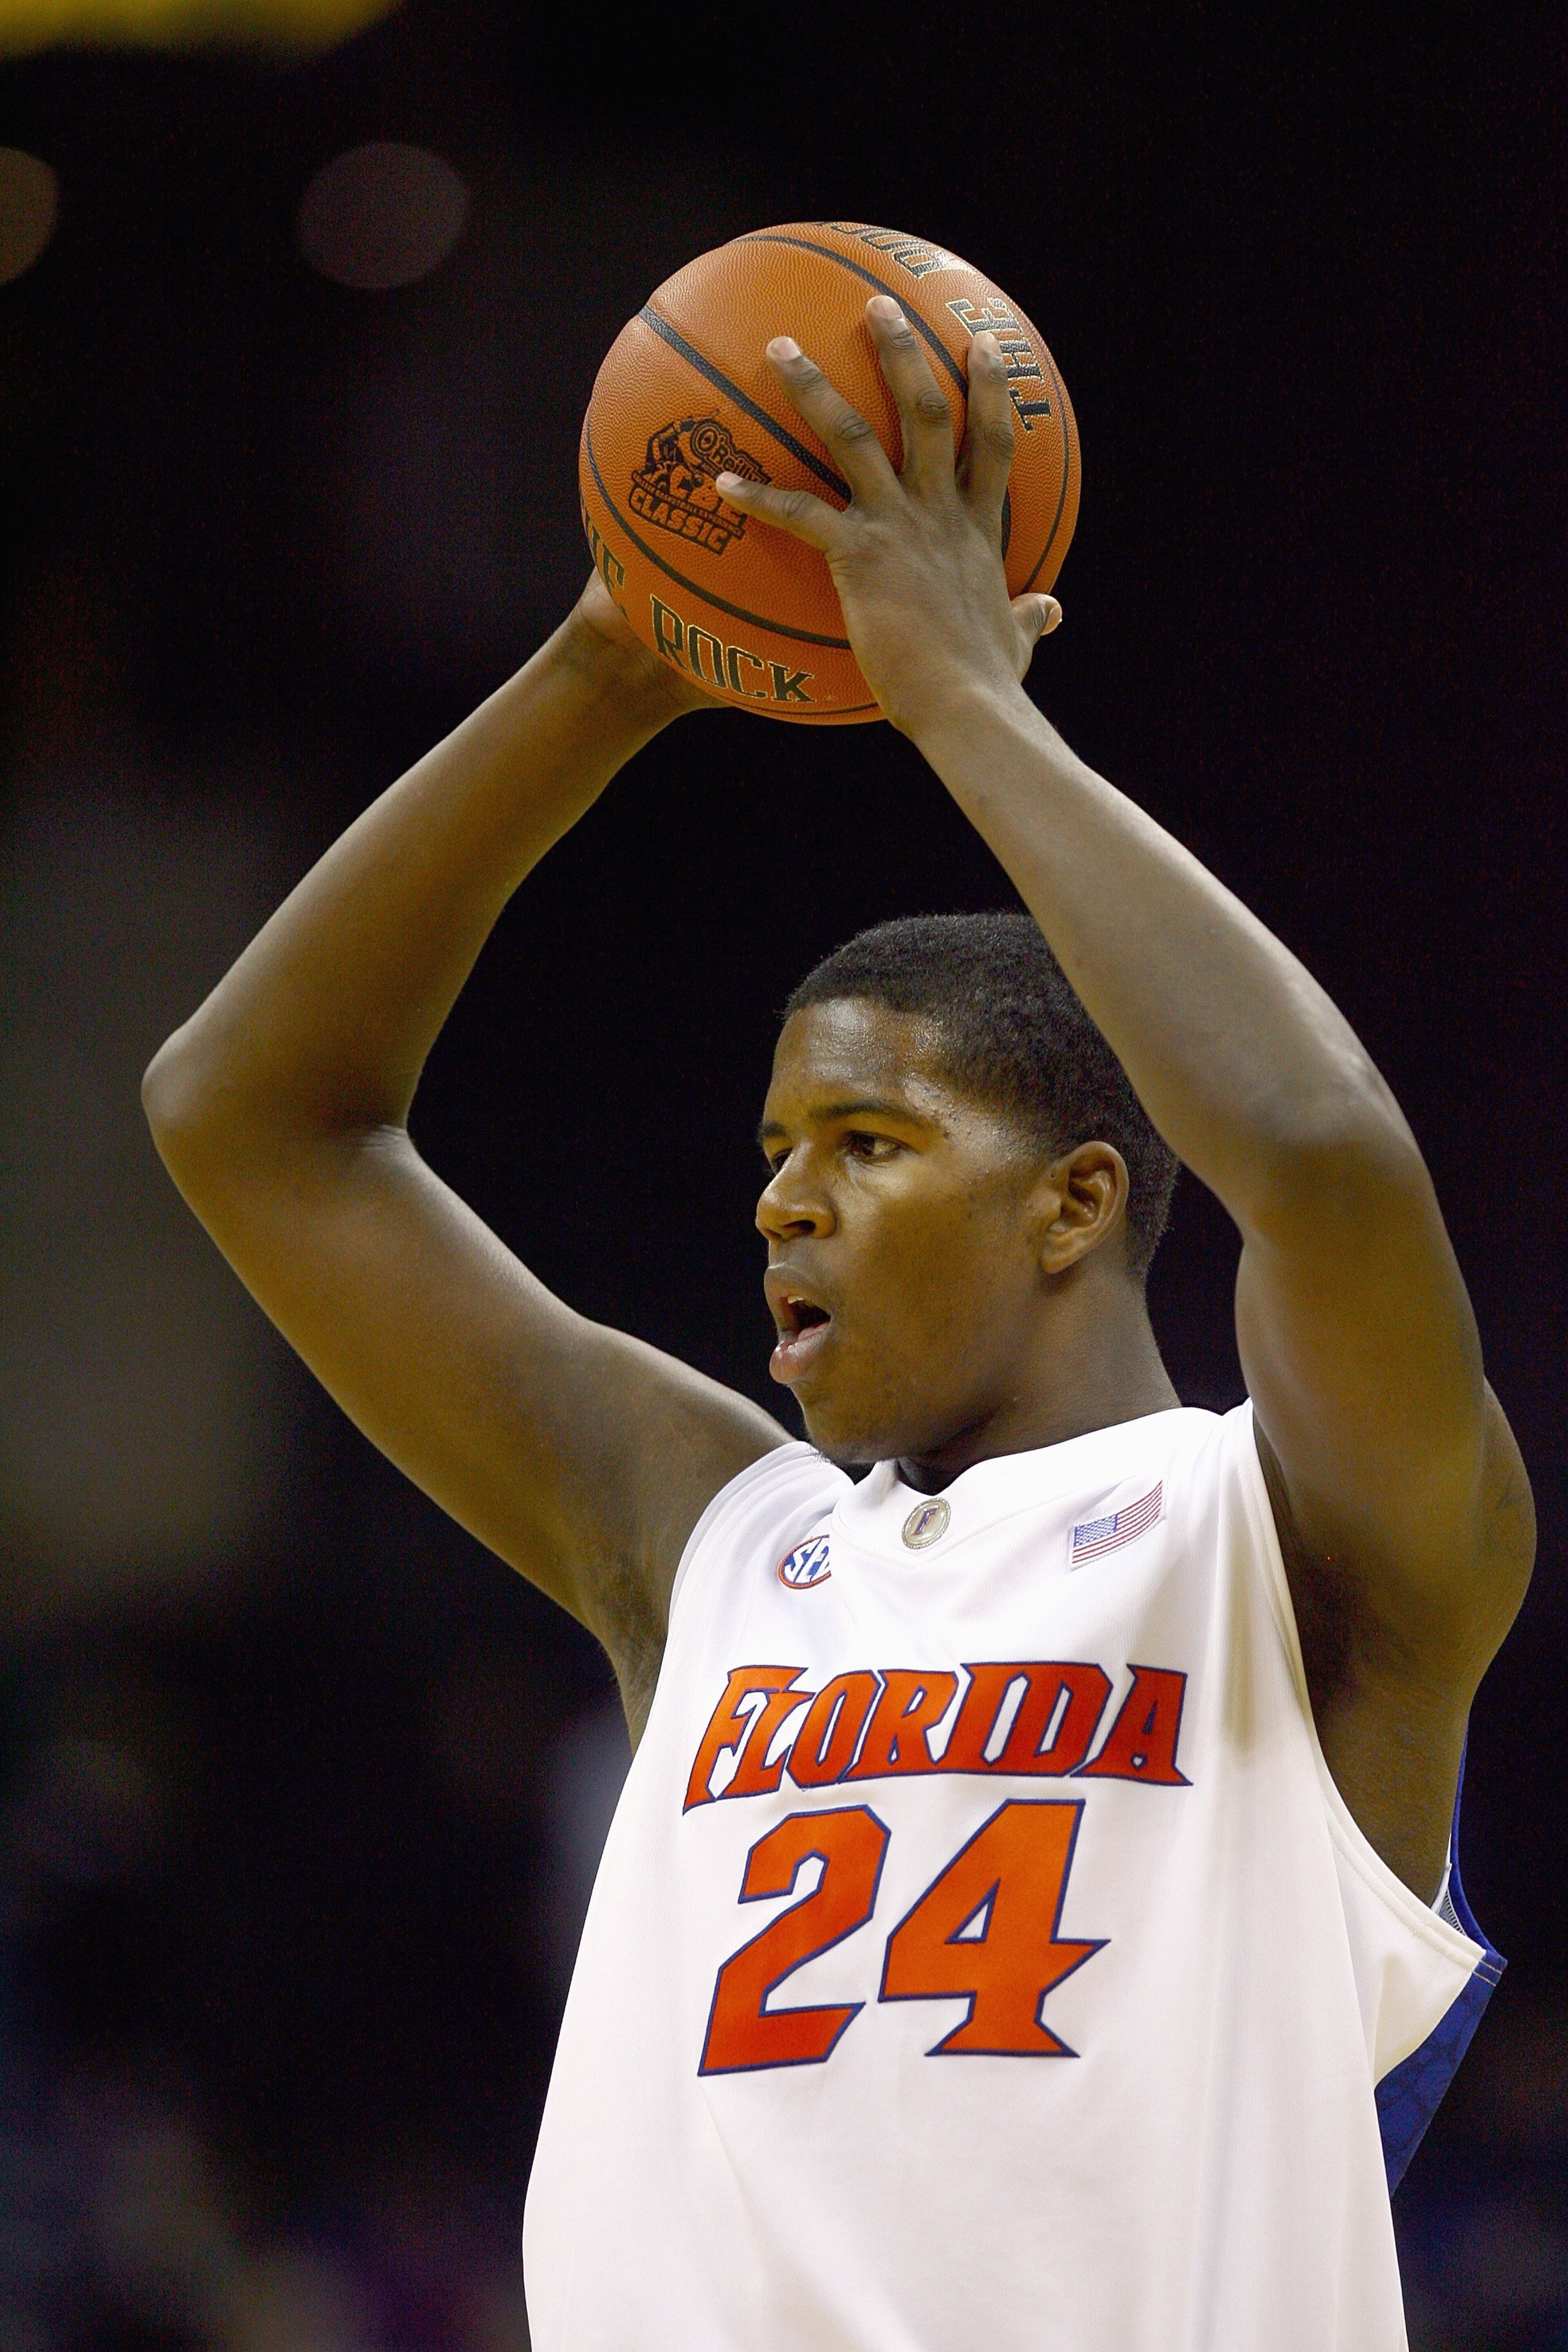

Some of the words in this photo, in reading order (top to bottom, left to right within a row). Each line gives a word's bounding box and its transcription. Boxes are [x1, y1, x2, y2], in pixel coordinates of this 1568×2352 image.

[946, 296, 1051, 433] THE
[630, 488, 728, 550] CLASSIC
[650, 594, 817, 703] ROCK
[682, 1661, 1194, 1816] FLORIDA
[697, 1798, 1111, 2076] 24
